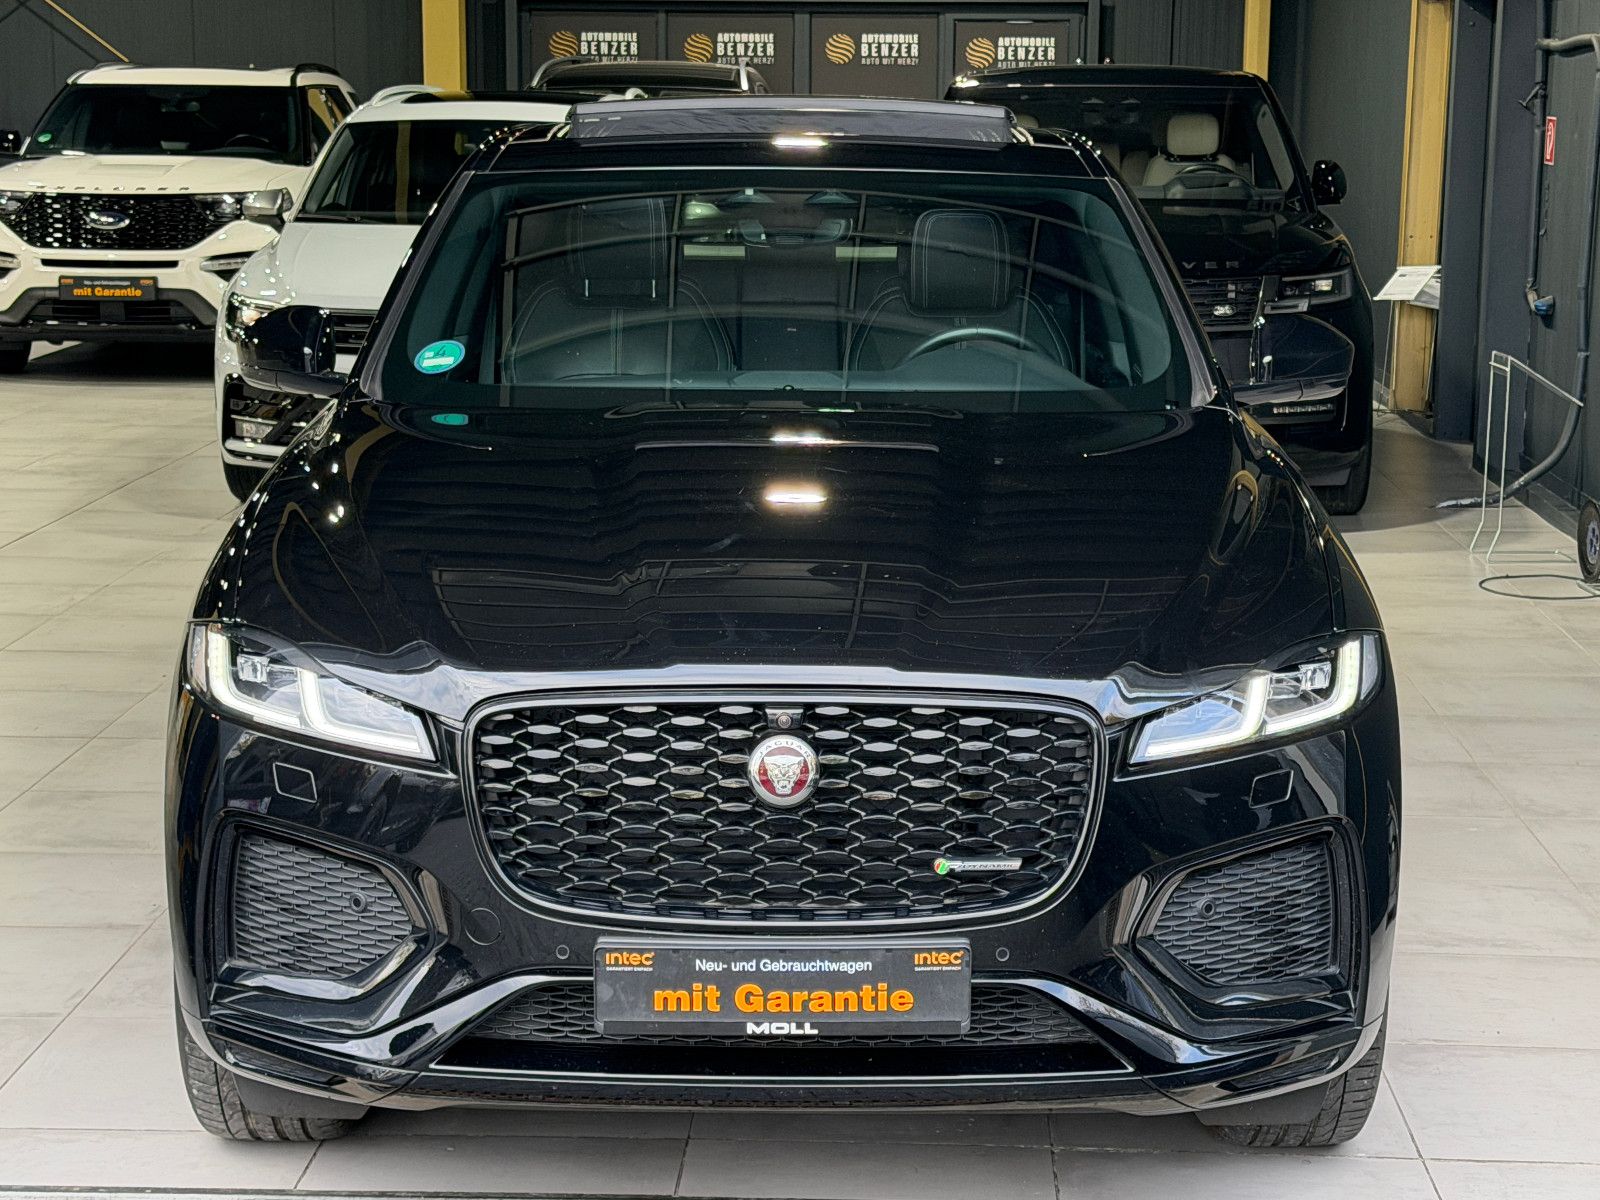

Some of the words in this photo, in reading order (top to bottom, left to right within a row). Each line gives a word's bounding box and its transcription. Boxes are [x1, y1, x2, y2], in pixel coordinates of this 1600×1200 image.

[580, 32, 638, 42] AUTOMOBILE
[717, 33, 775, 43] AUTOMOBILE
[861, 34, 919, 43] AUTOMOBILE
[998, 37, 1056, 47] AUTOMOBILE
[580, 42, 638, 55] BENZER
[716, 43, 775, 56] BENZER
[861, 43, 919, 57] BENZER
[997, 47, 1056, 60] BENZER
[1182, 261, 1239, 269] VER
[73, 287, 93, 296] mit
[94, 286, 142, 297] Garantie
[695, 959, 728, 972] Neu-
[731, 959, 757, 972] und
[760, 959, 873, 974] Gebrauchtwagen
[654, 983, 721, 1012] mit
[734, 982, 915, 1013] Garantie
[746, 1022, 819, 1035] MOLL
